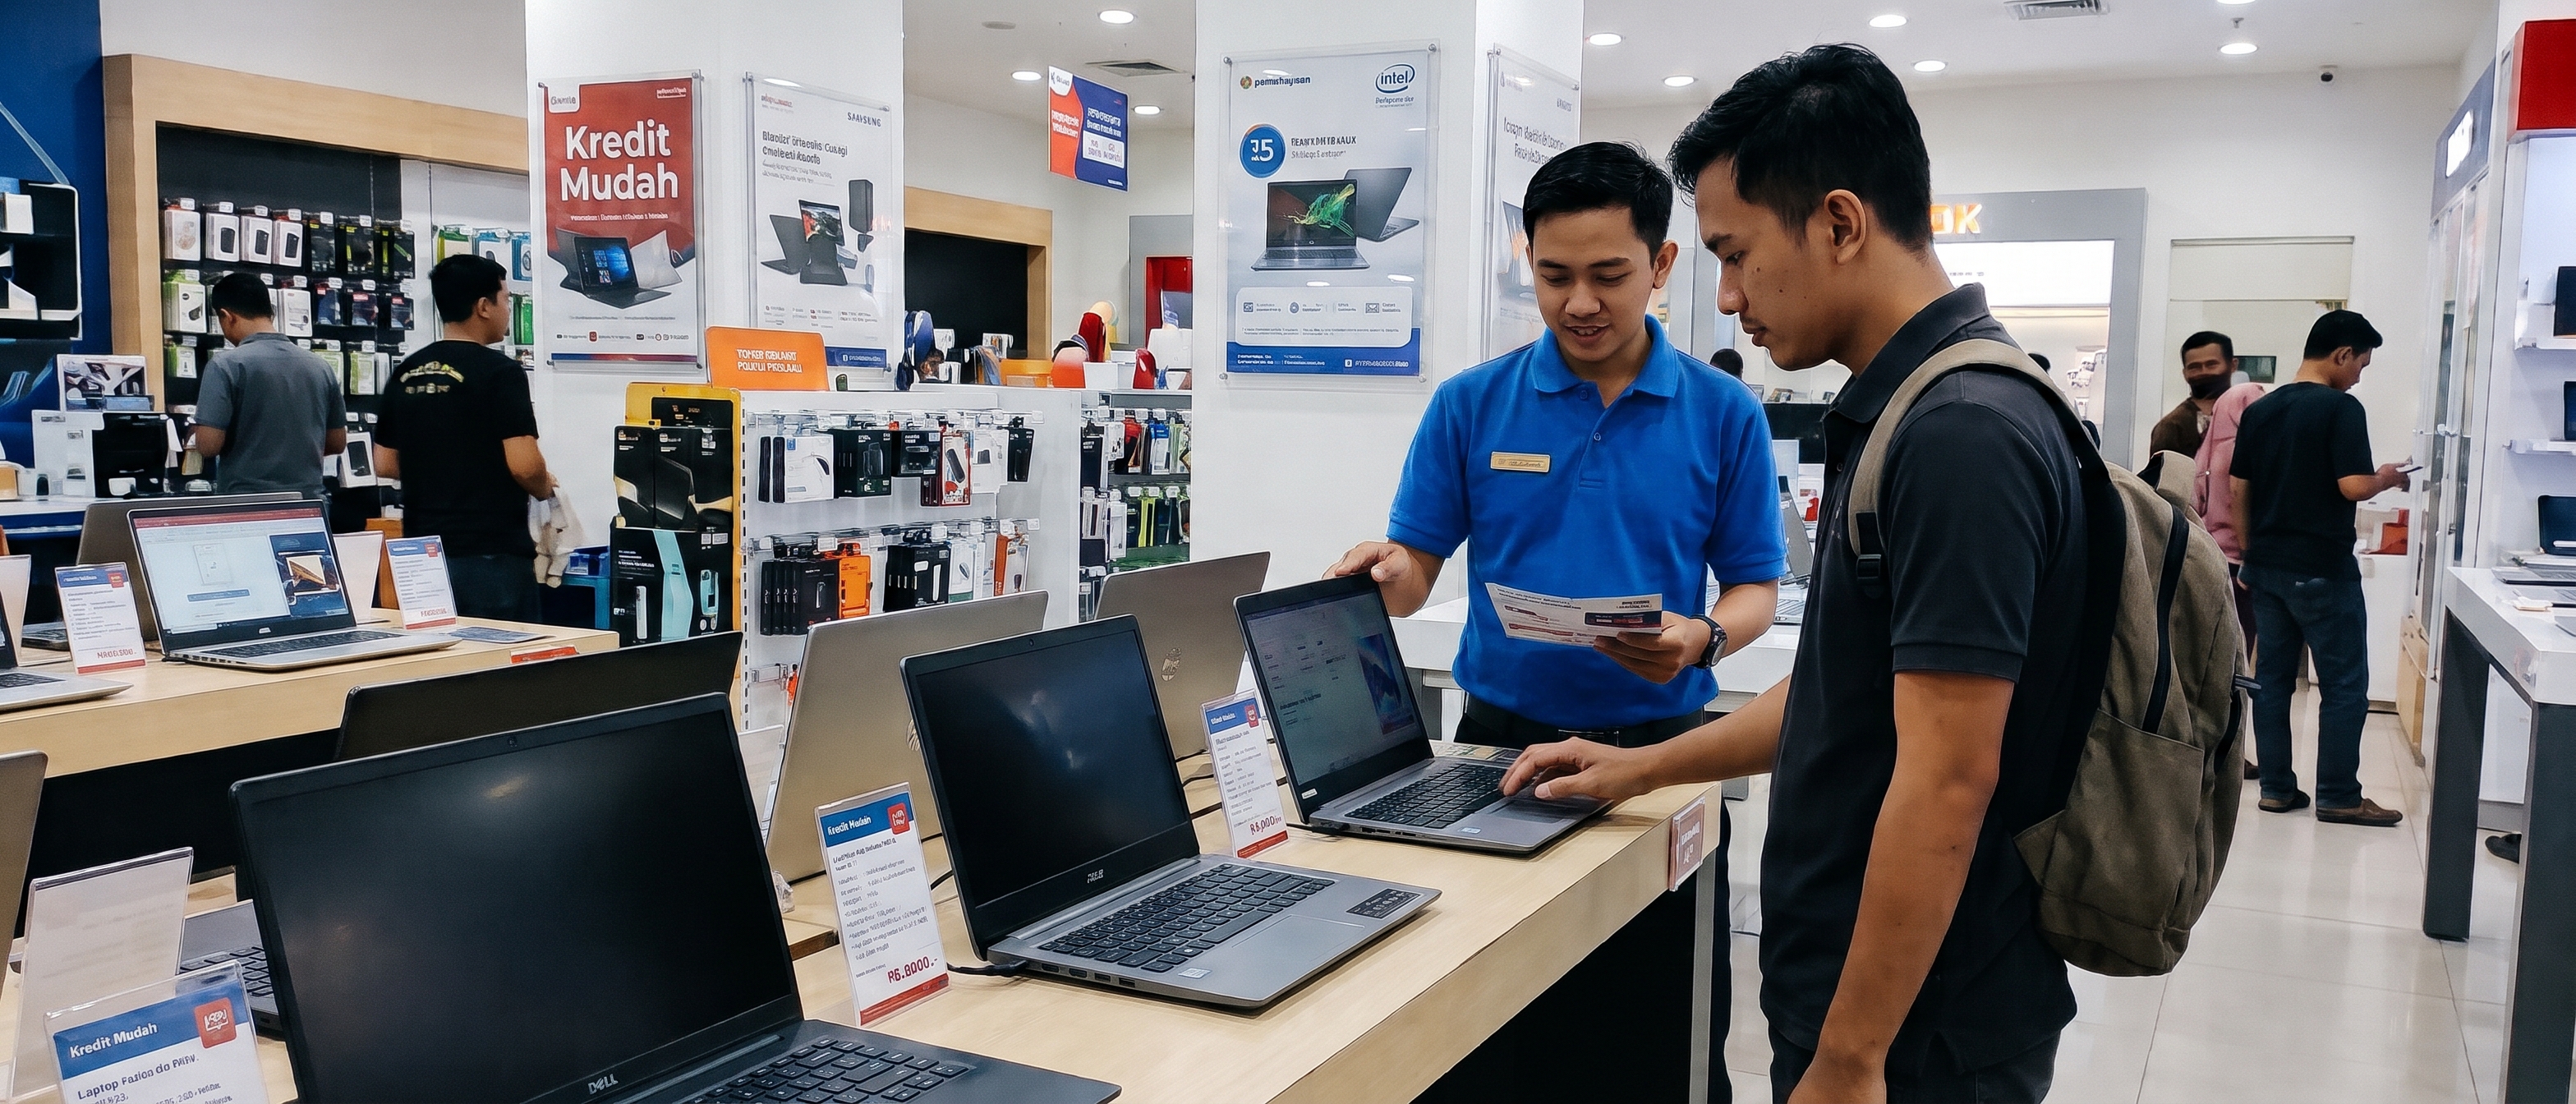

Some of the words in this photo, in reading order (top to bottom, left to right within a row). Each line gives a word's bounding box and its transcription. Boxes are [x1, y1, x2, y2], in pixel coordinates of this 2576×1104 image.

[1381, 70, 1409, 85] intel
[565, 118, 671, 160] Kredit
[560, 162, 678, 201] Mudah
[69, 1037, 112, 1059] Kredit
[113, 1022, 159, 1045] Mudah
[77, 1080, 119, 1100] Laptop
